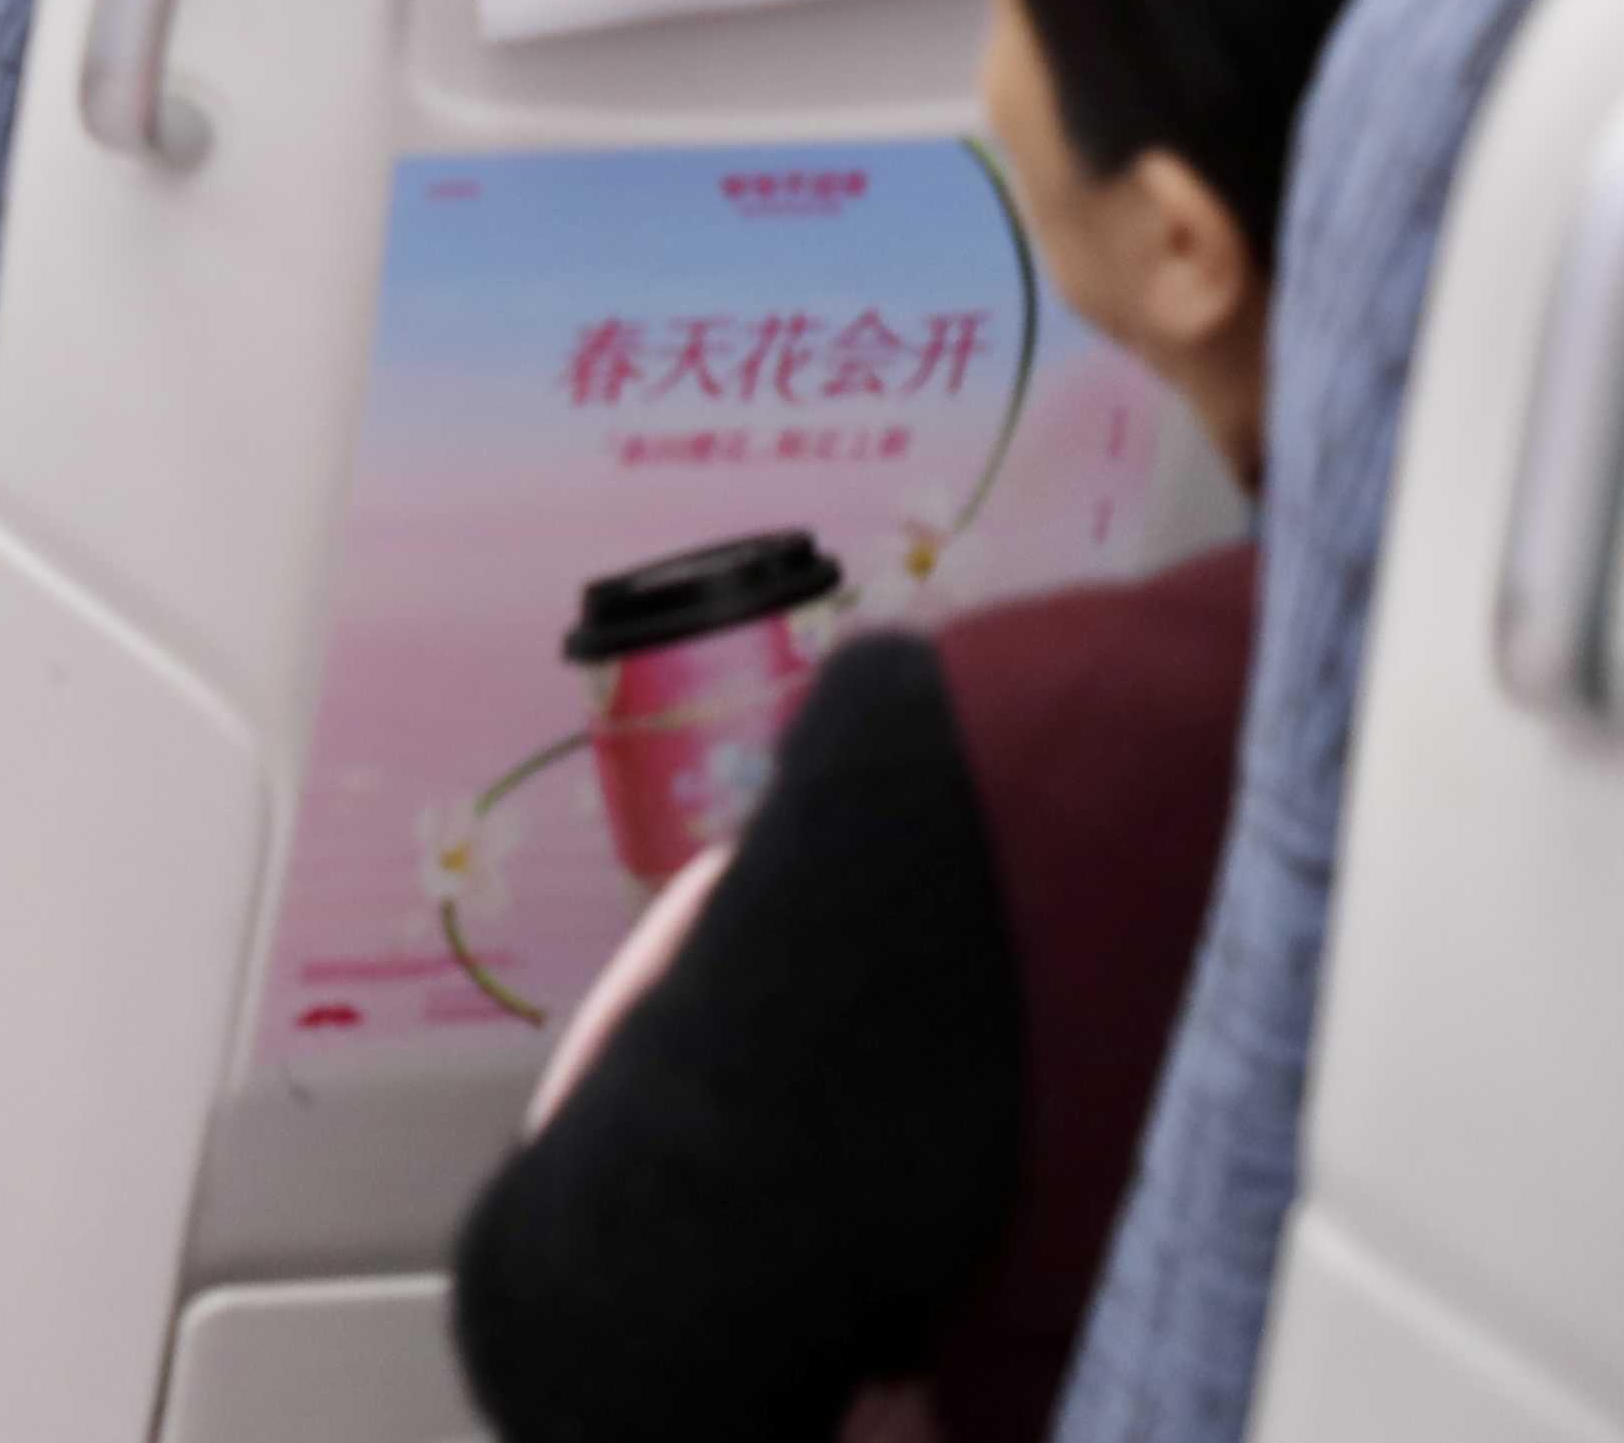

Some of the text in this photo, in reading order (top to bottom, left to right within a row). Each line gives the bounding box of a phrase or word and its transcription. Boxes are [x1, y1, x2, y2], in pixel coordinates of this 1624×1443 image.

[559, 306, 995, 409] 春天花会开
